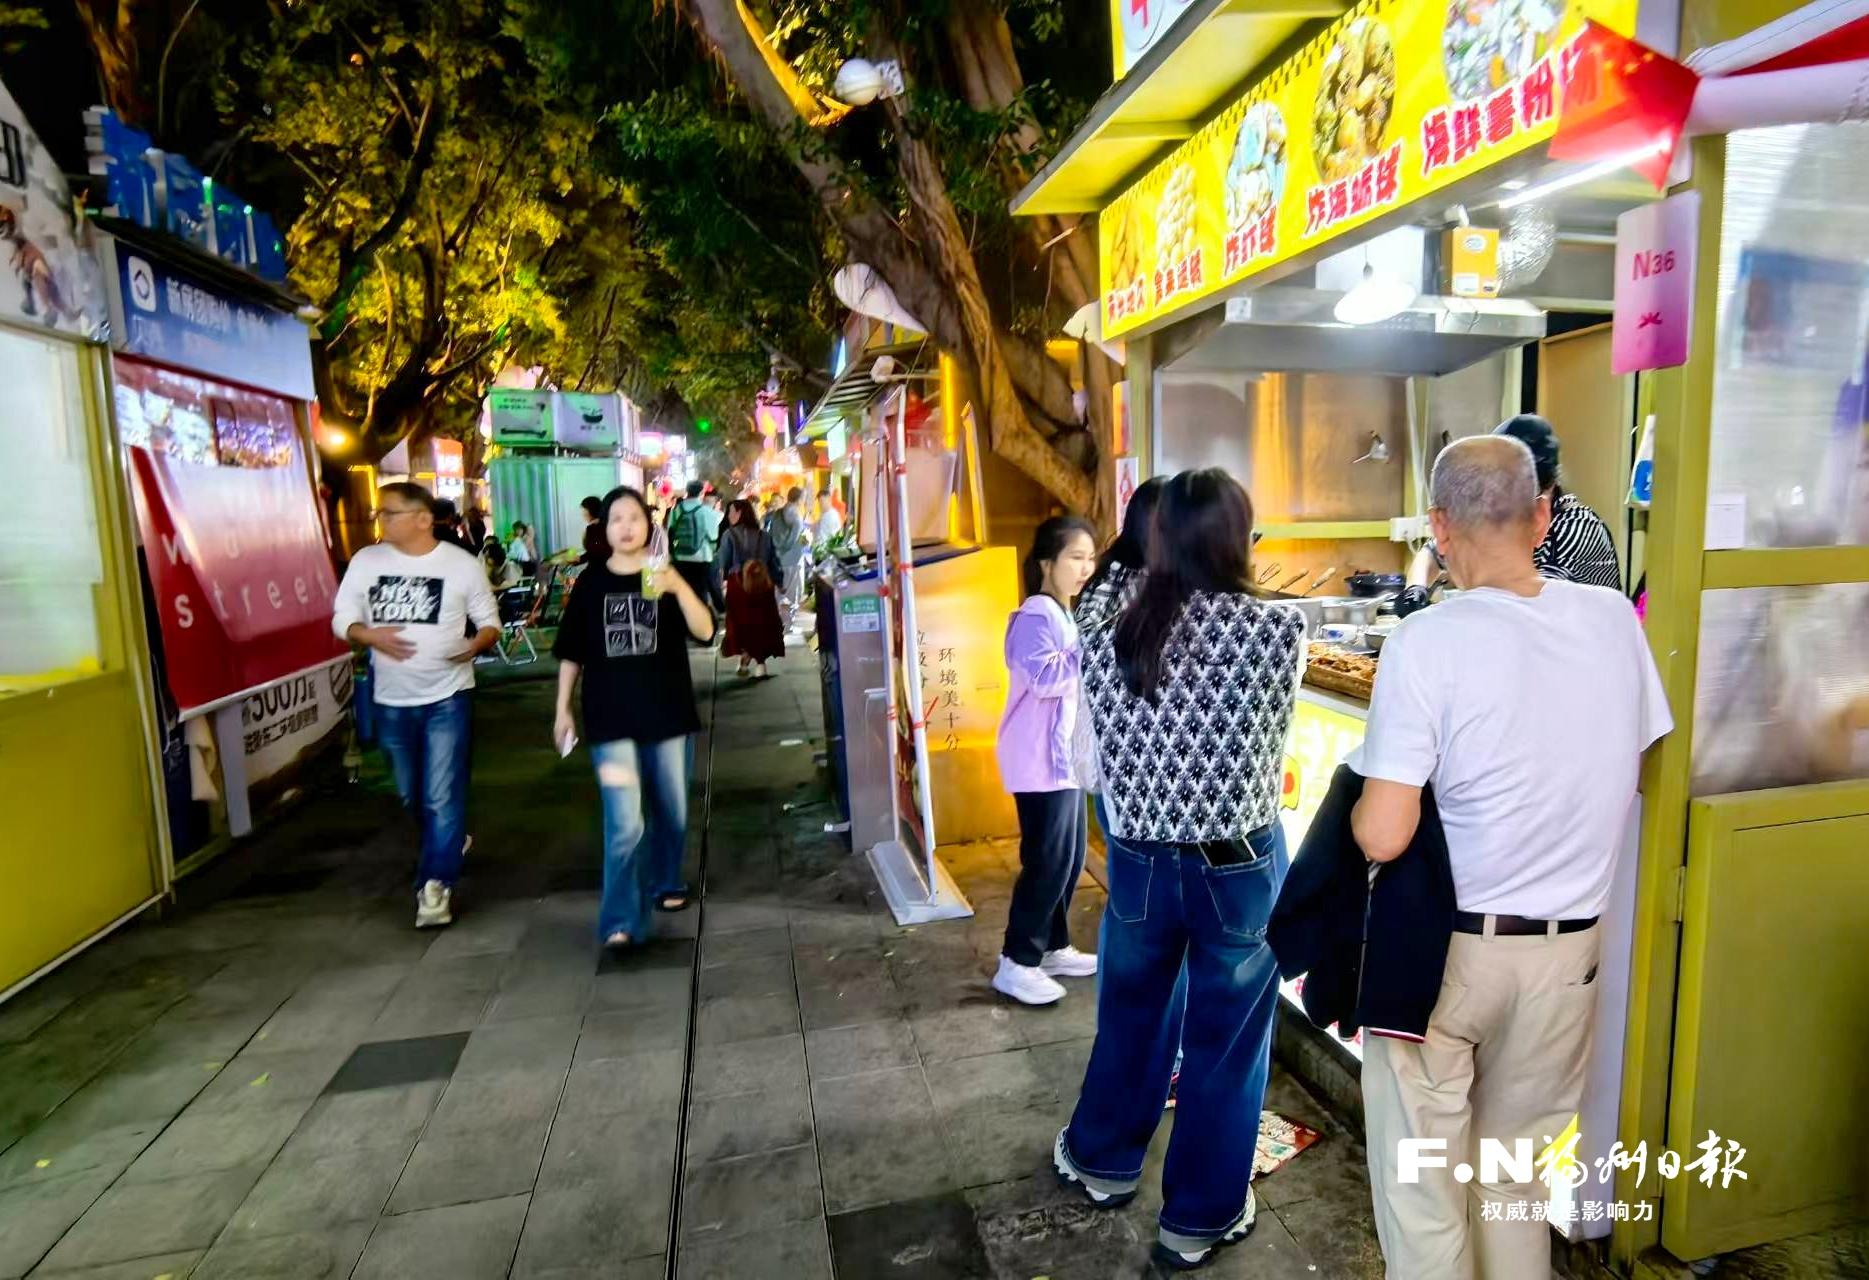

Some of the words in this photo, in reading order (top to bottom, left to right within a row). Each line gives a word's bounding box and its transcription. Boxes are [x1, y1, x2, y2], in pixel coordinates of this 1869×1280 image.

[1632, 249, 1675, 280] N36
[938, 647, 959, 753] 环境美十分
